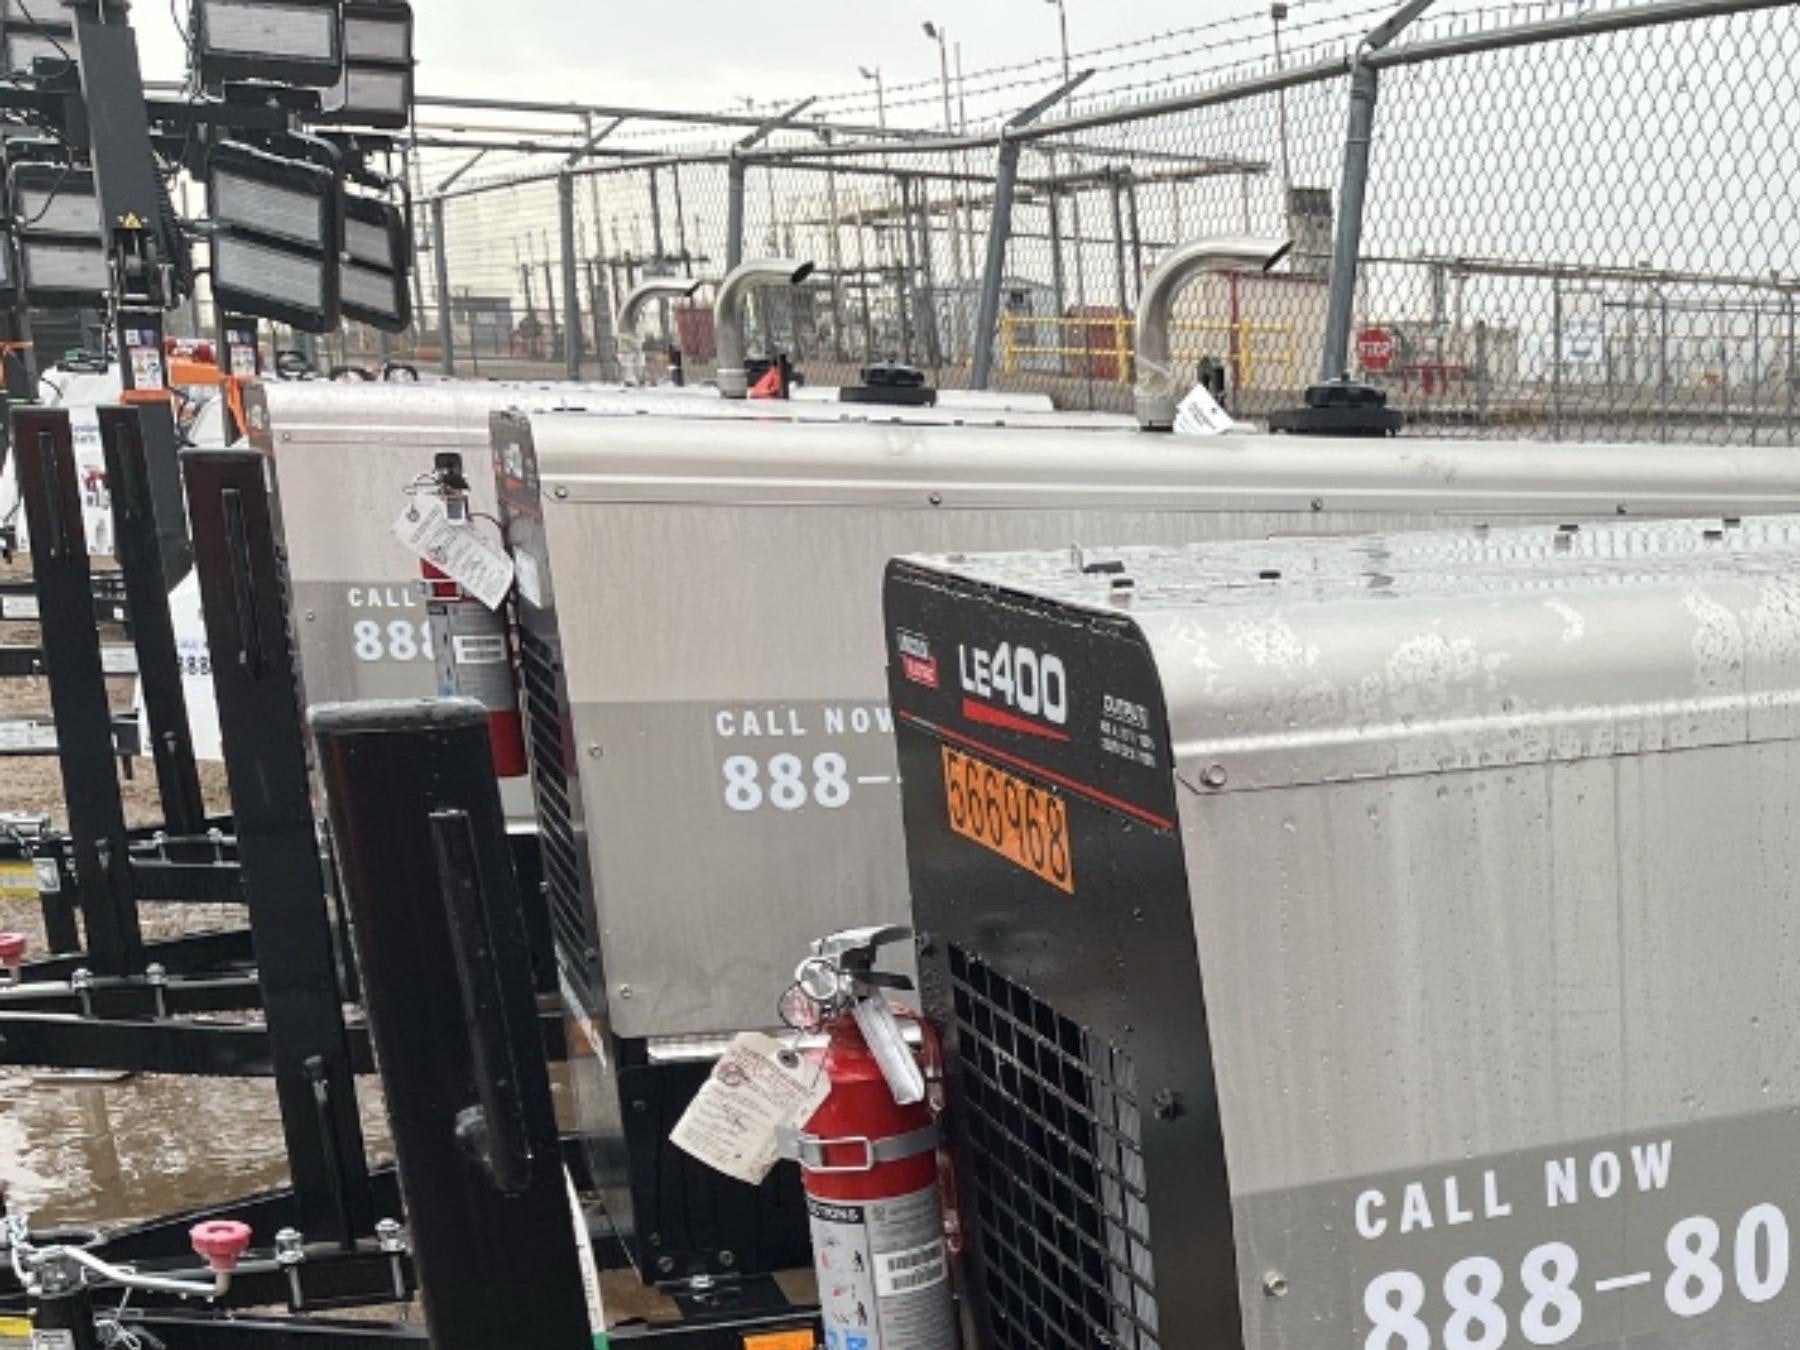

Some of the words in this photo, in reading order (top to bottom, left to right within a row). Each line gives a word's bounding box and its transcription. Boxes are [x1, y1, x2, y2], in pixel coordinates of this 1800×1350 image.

[347, 587, 417, 607] CALL
[715, 710, 807, 737] CALL
[959, 640, 1067, 725] LE400
[947, 751, 1067, 883] 566968
[1354, 1170, 1513, 1240] CALL
[1546, 1140, 1674, 1205] NOW
